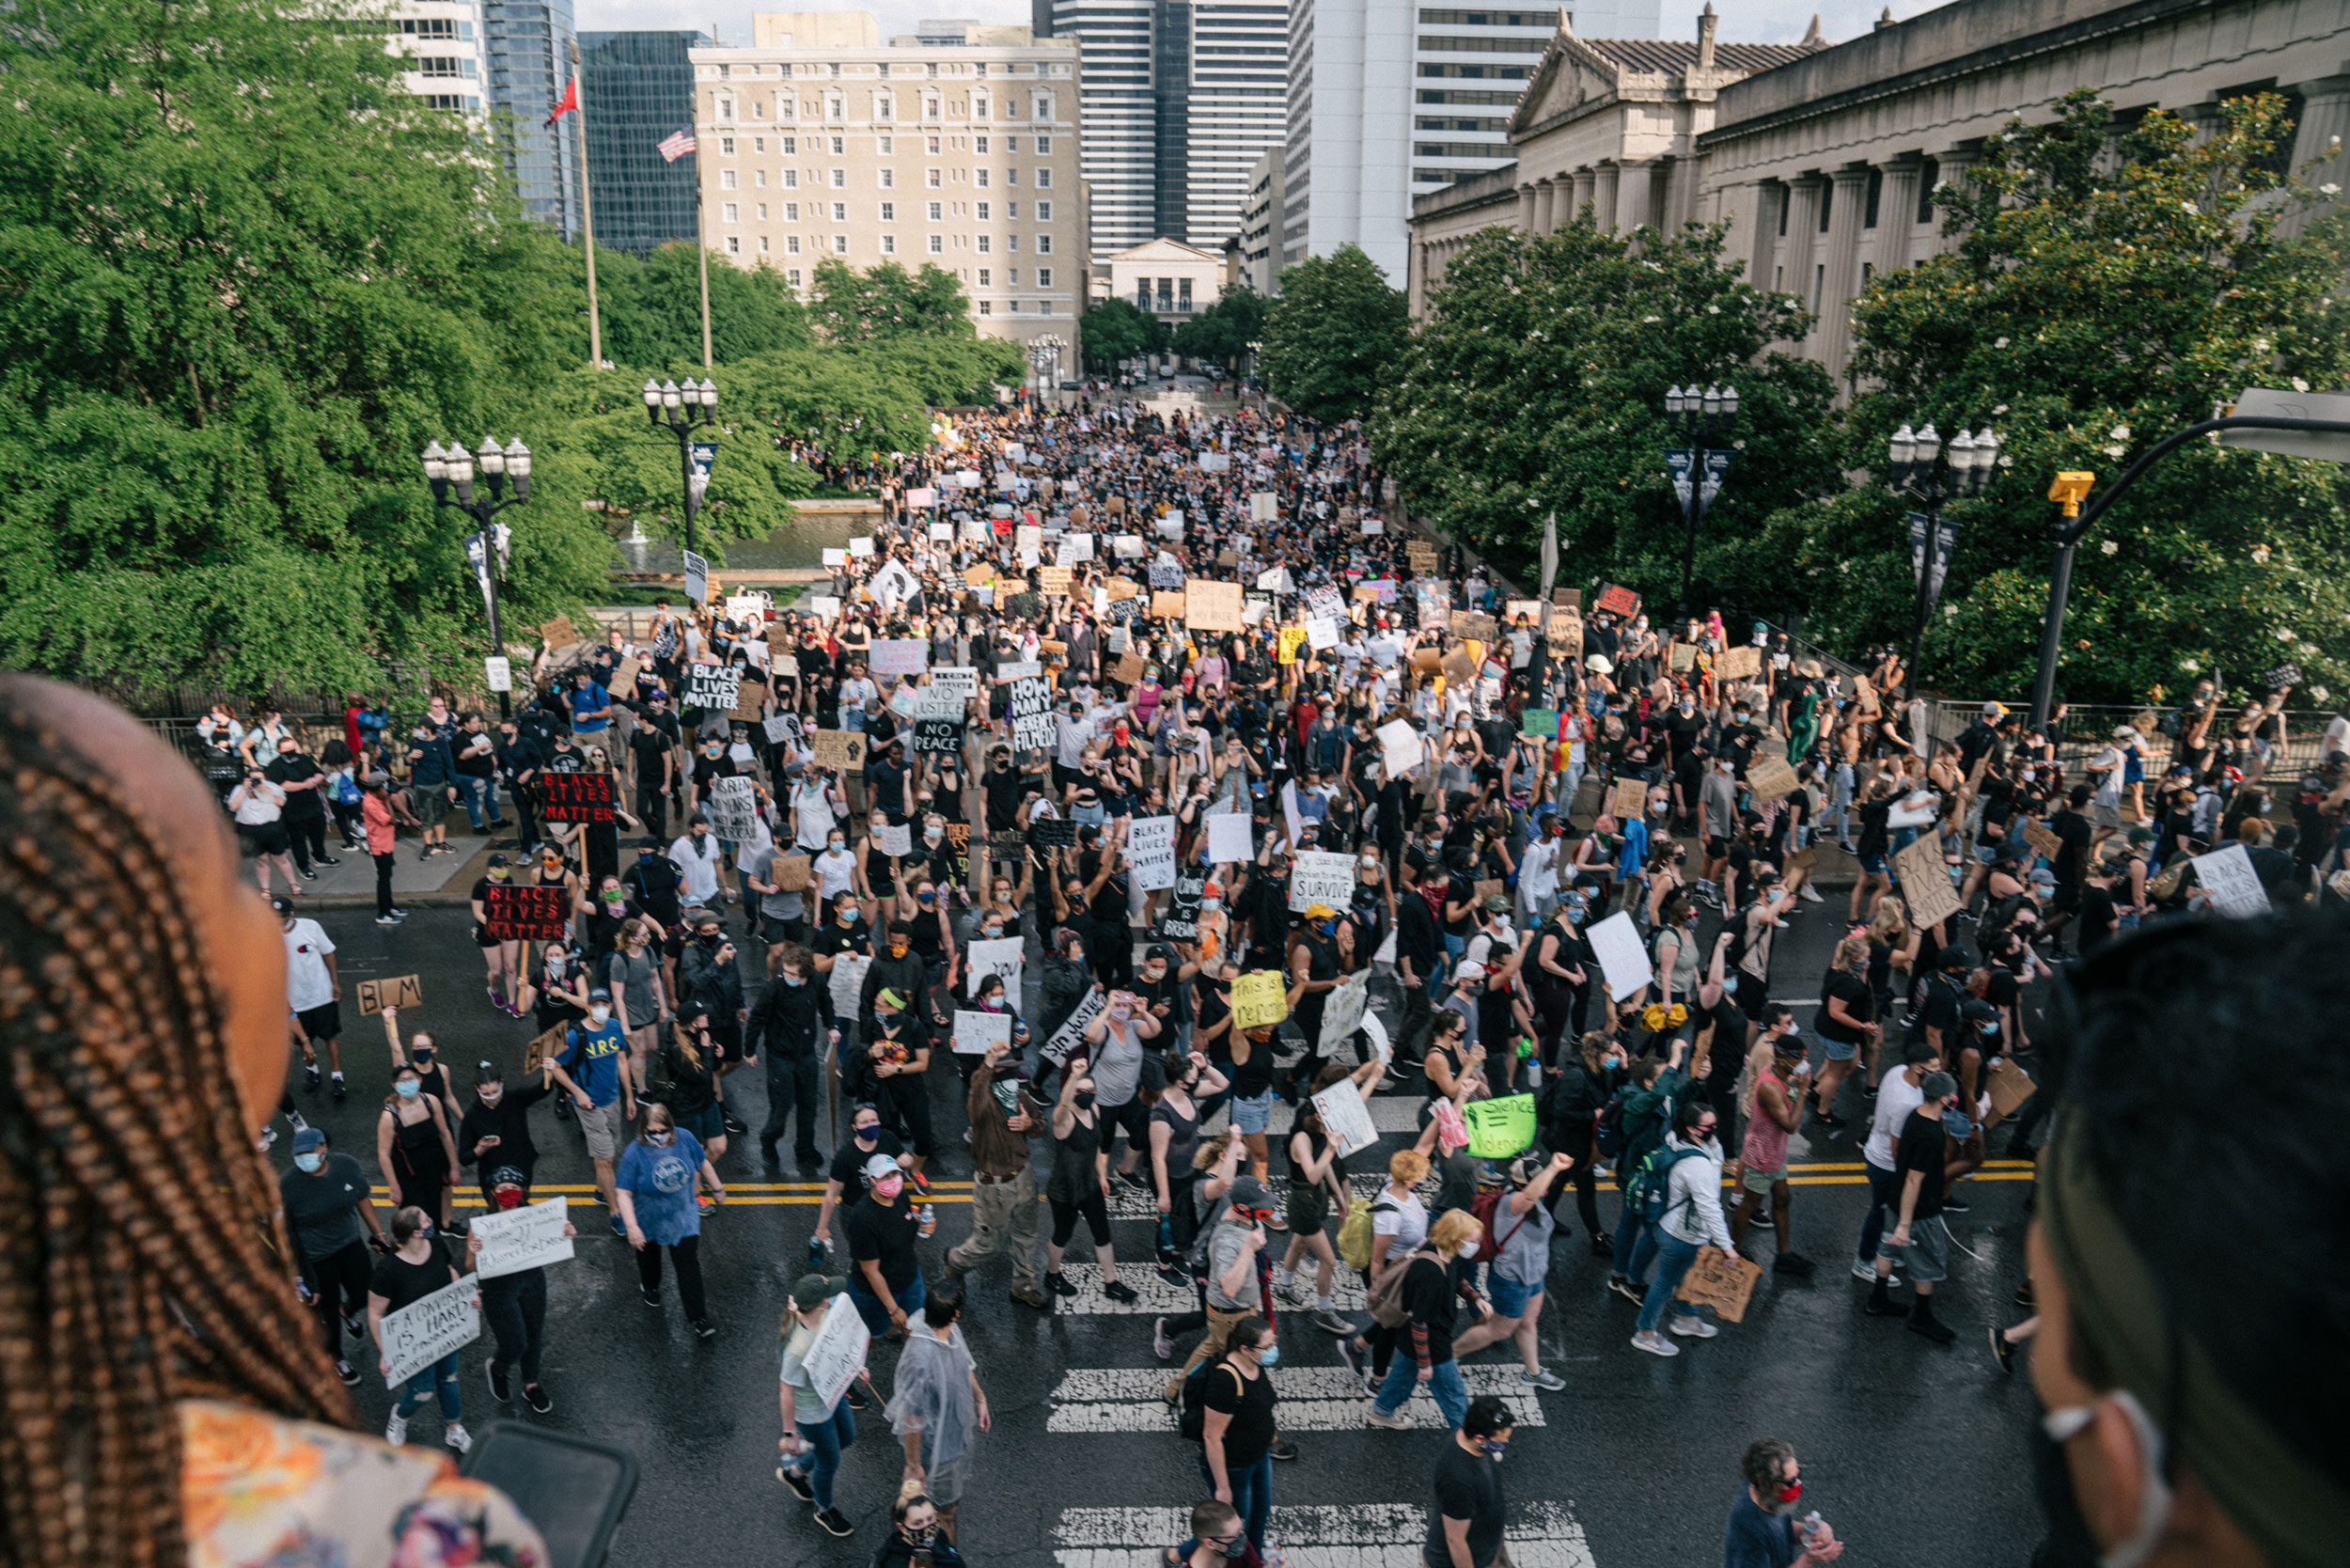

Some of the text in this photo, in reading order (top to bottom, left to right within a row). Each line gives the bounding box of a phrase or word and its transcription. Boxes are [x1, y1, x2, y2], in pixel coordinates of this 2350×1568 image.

[693, 664, 740, 681] BLACK
[692, 679, 741, 695] LIVES
[929, 687, 955, 700] NO
[1010, 677, 1051, 701] HOW
[682, 694, 740, 711] MATTER
[913, 701, 964, 715] JUSTICE
[1011, 696, 1053, 717] MANY
[925, 723, 952, 737] NO
[914, 736, 960, 751] PEACE
[543, 773, 607, 789] BLACK
[550, 788, 610, 802] LIVES
[545, 806, 615, 822] MATTER
[1134, 824, 1167, 839] BLACK
[1134, 839, 1167, 852] LIVES
[1134, 853, 1171, 868] MATTER
[489, 886, 560, 902] BLACK
[1296, 880, 1350, 898] SURVIVE
[492, 902, 557, 920] LIVES
[487, 921, 564, 940] MATTER
[993, 961, 1020, 978] YOU
[362, 978, 422, 1014] BLM
[397, 1301, 469, 1350] IS HARD
